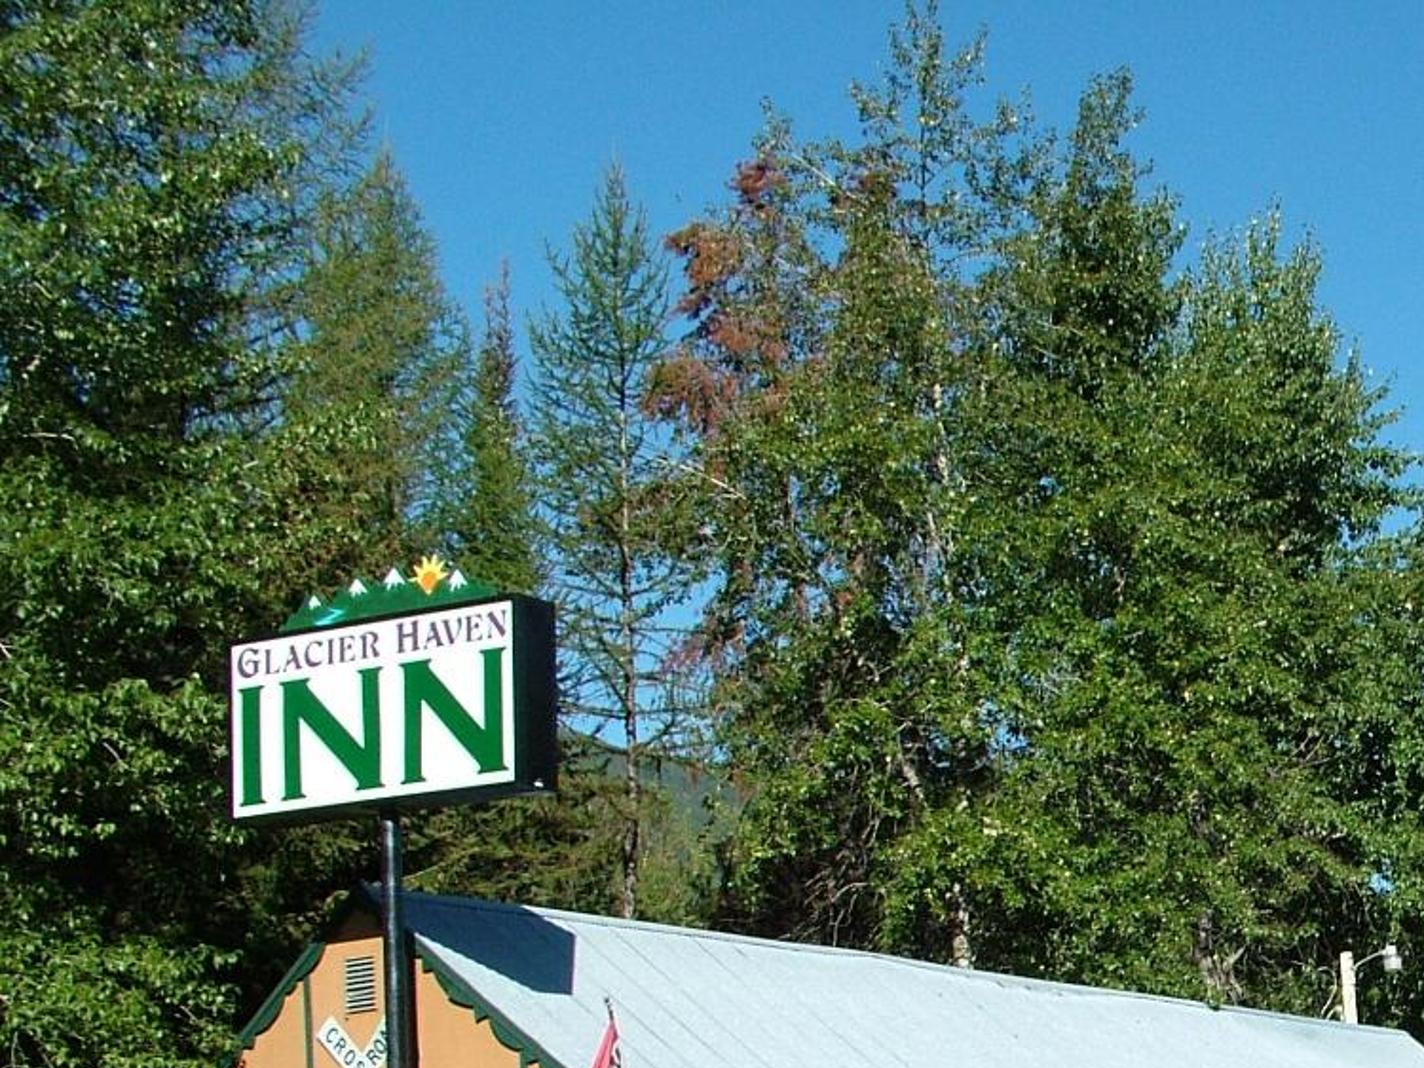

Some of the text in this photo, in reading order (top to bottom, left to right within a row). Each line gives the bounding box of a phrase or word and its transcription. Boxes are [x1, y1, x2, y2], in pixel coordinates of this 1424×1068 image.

[237, 609, 508, 679] GLACIER HAVEN
[237, 647, 509, 808] INN
